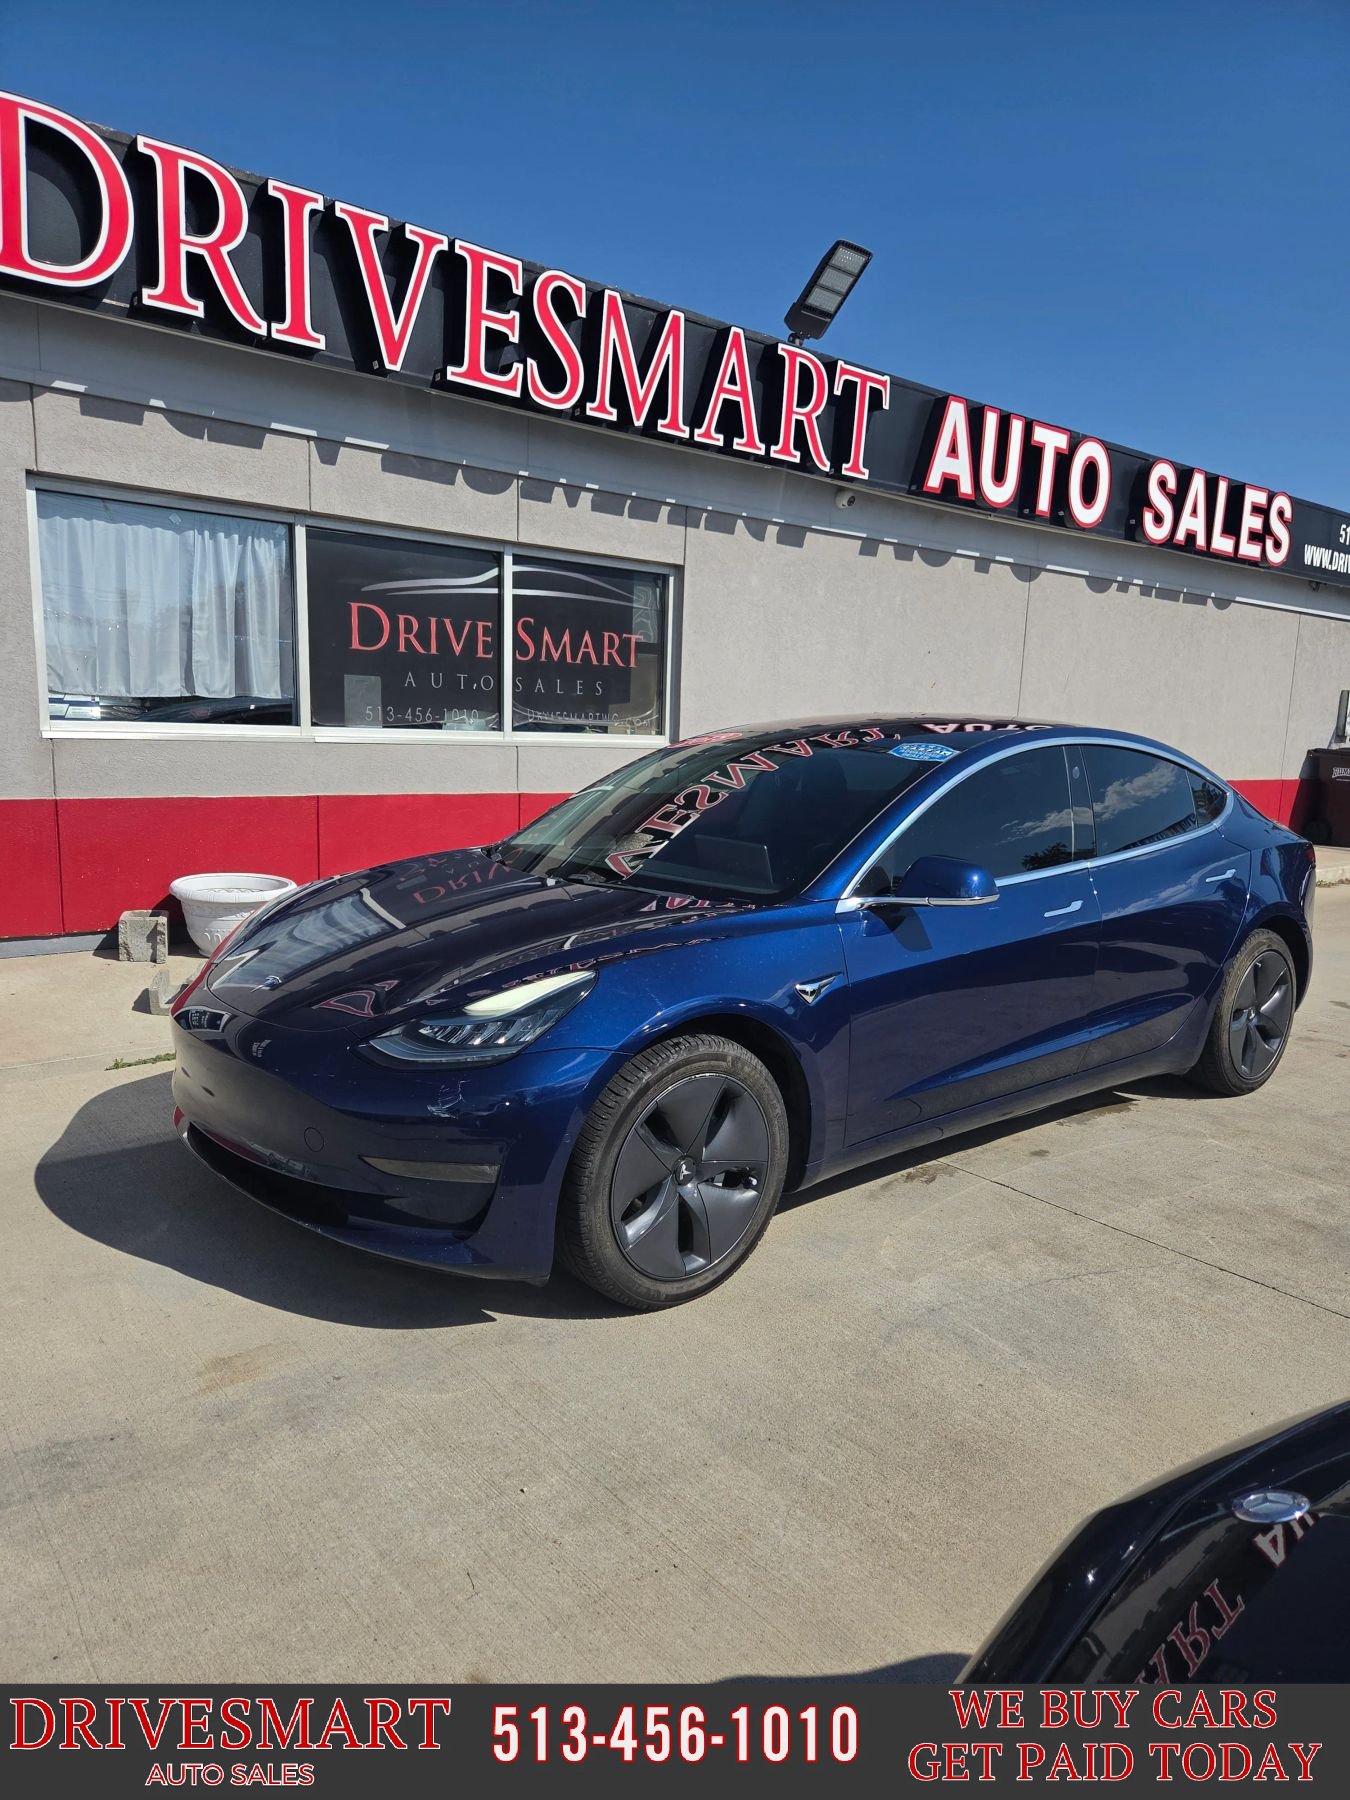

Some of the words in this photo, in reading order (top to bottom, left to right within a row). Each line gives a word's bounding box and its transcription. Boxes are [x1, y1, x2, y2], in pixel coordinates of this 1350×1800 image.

[0, 90, 891, 480] DRIVESMART
[922, 395, 1112, 529] AUTO
[1142, 459, 1293, 568] SALES
[347, 601, 494, 659] DRIVE
[515, 617, 643, 668] SMART
[404, 671, 494, 692] AUTO
[515, 676, 603, 696] SALES
[365, 705, 479, 723] 513-456-1010
